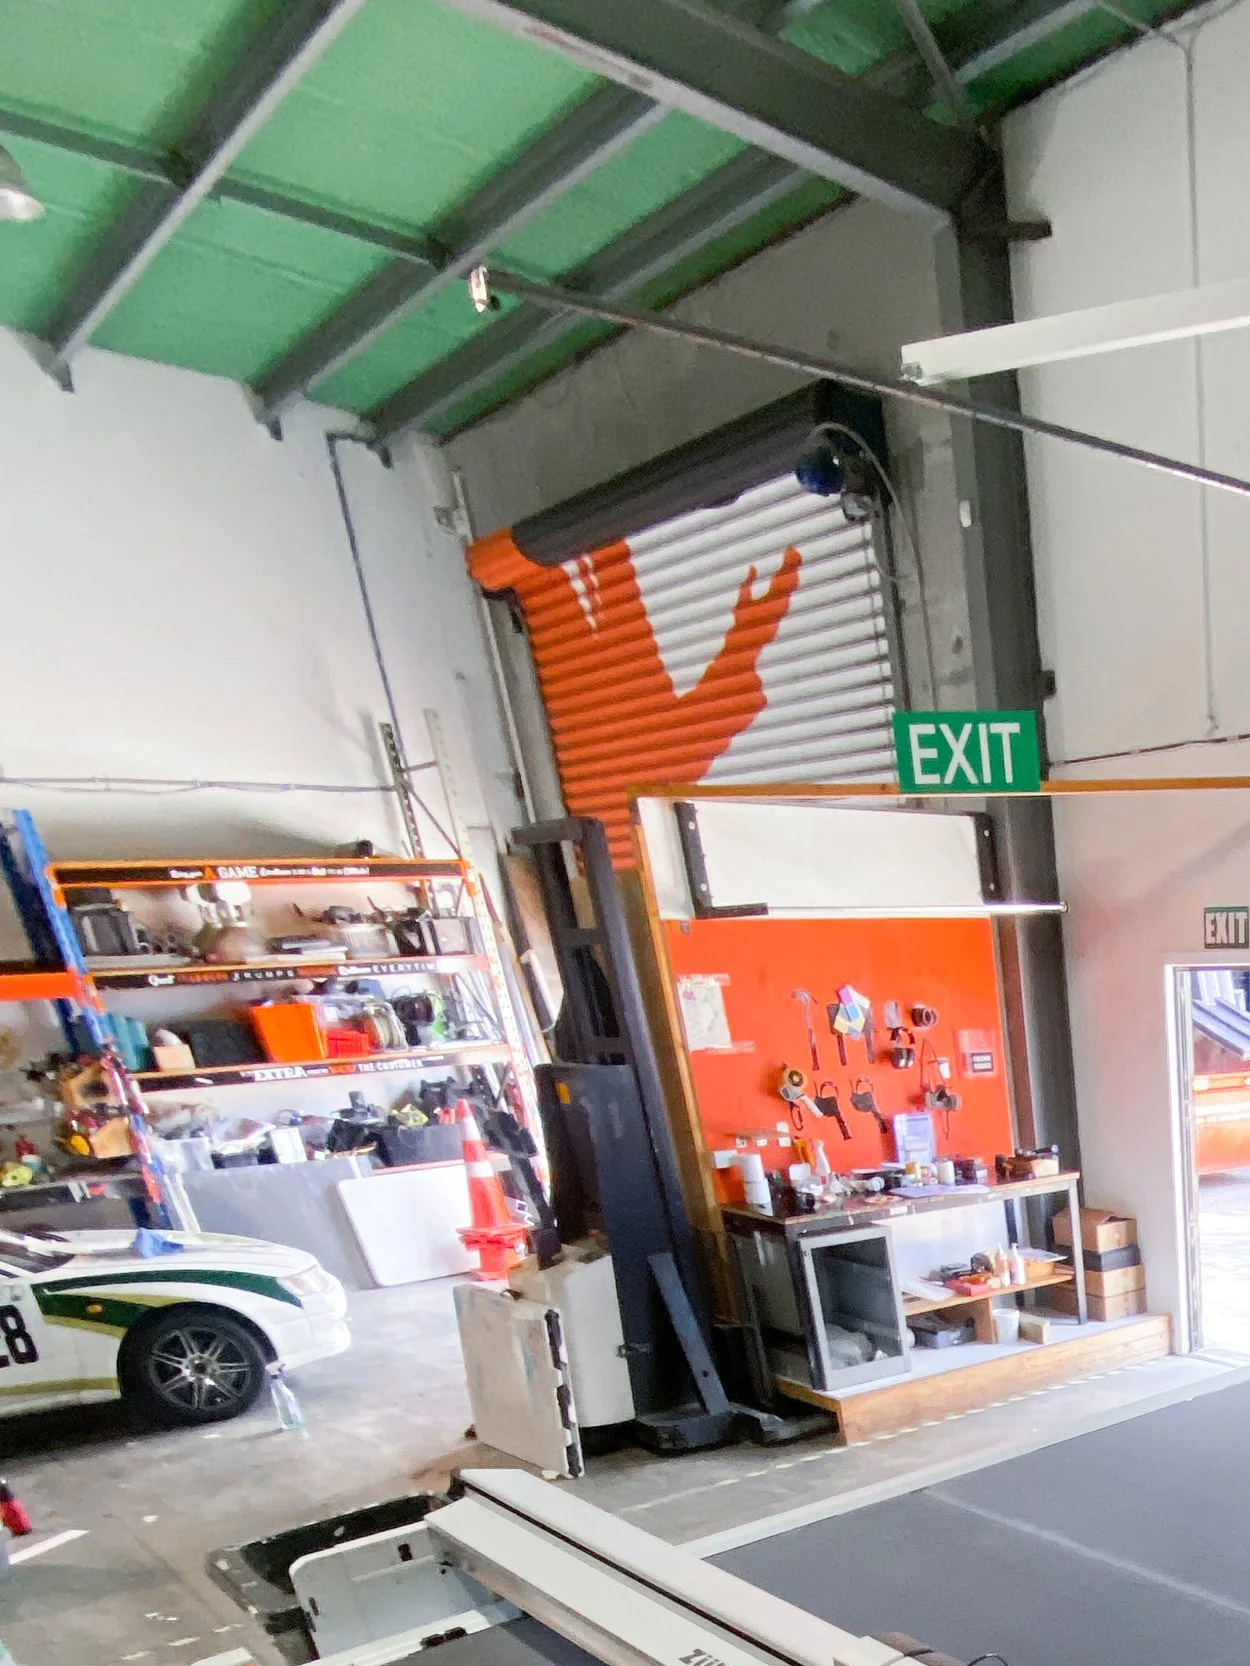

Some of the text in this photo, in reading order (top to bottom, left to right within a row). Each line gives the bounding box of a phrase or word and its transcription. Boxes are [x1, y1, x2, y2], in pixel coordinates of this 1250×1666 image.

[908, 722, 1021, 785] EXIT
[217, 866, 260, 880] GAME
[1205, 911, 1249, 944] EXIT
[0, 1304, 40, 1369] 8
